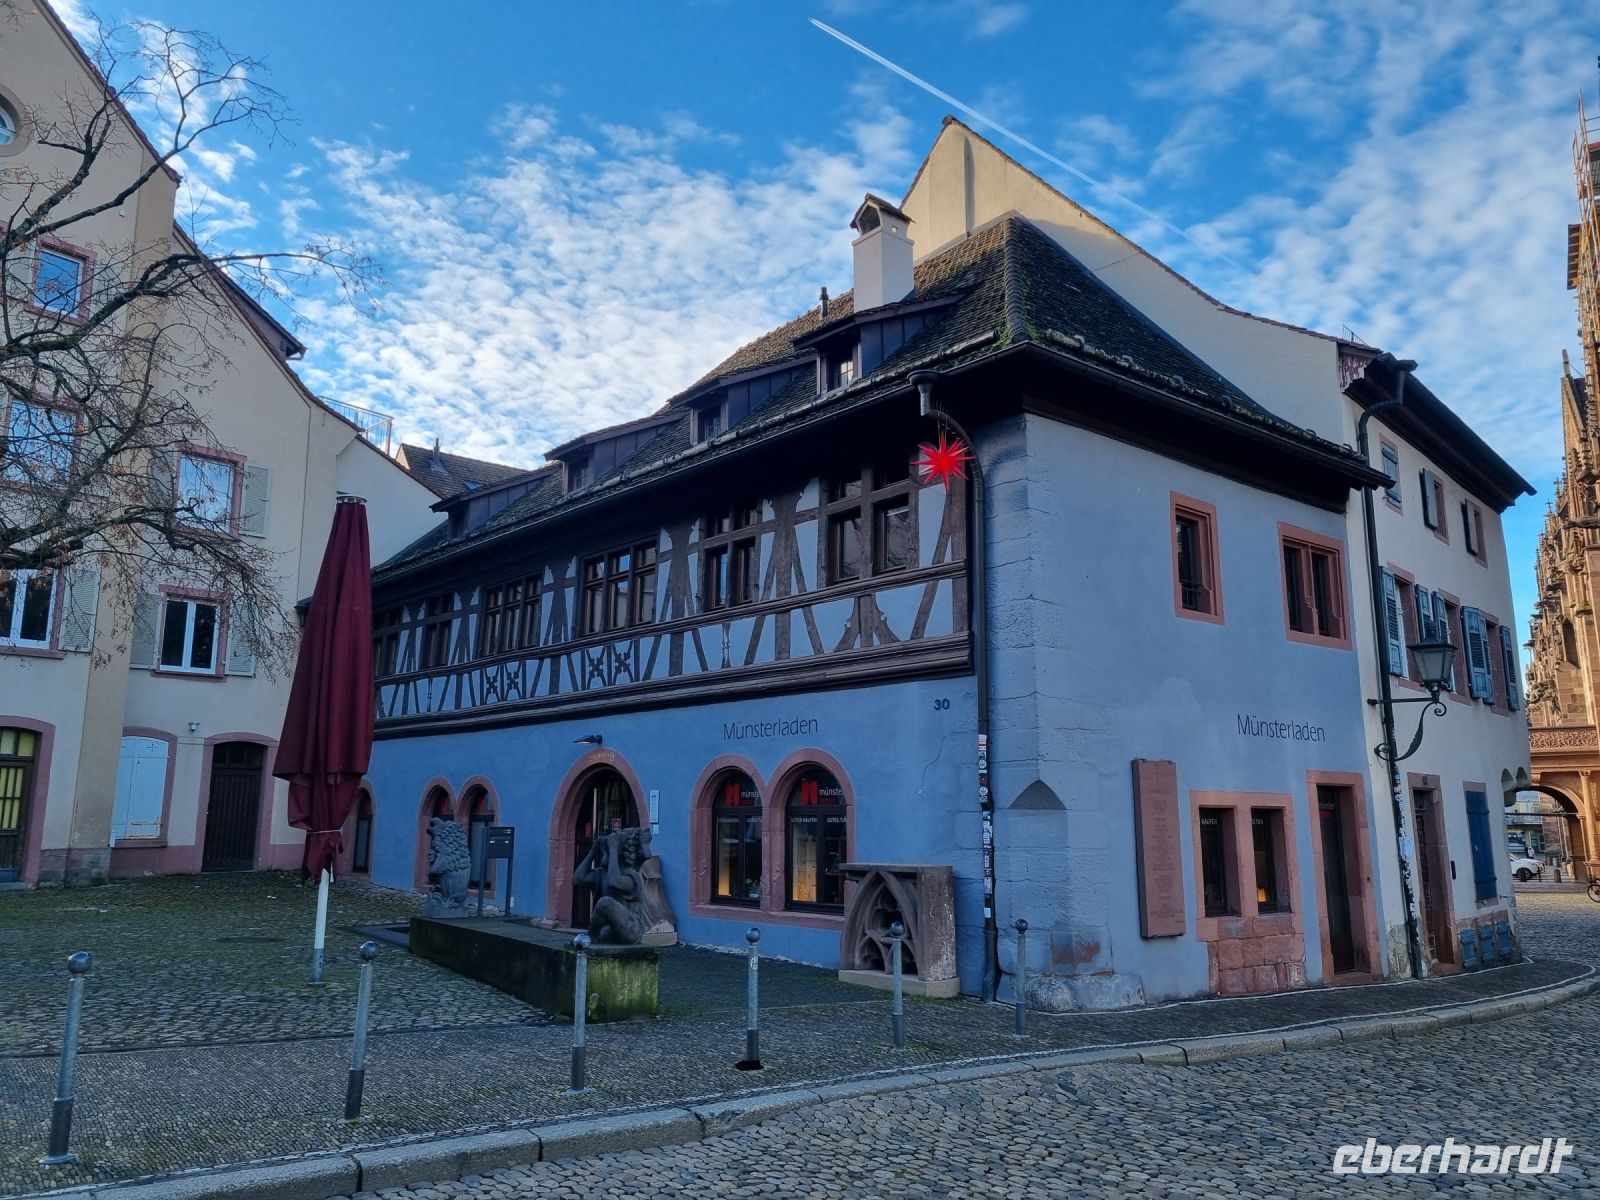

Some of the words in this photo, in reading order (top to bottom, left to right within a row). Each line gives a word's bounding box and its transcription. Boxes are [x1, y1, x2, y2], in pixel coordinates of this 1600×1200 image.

[934, 698, 951, 711] 30
[723, 716, 818, 741] Münsterladen
[1237, 713, 1326, 743] Münsterladen
